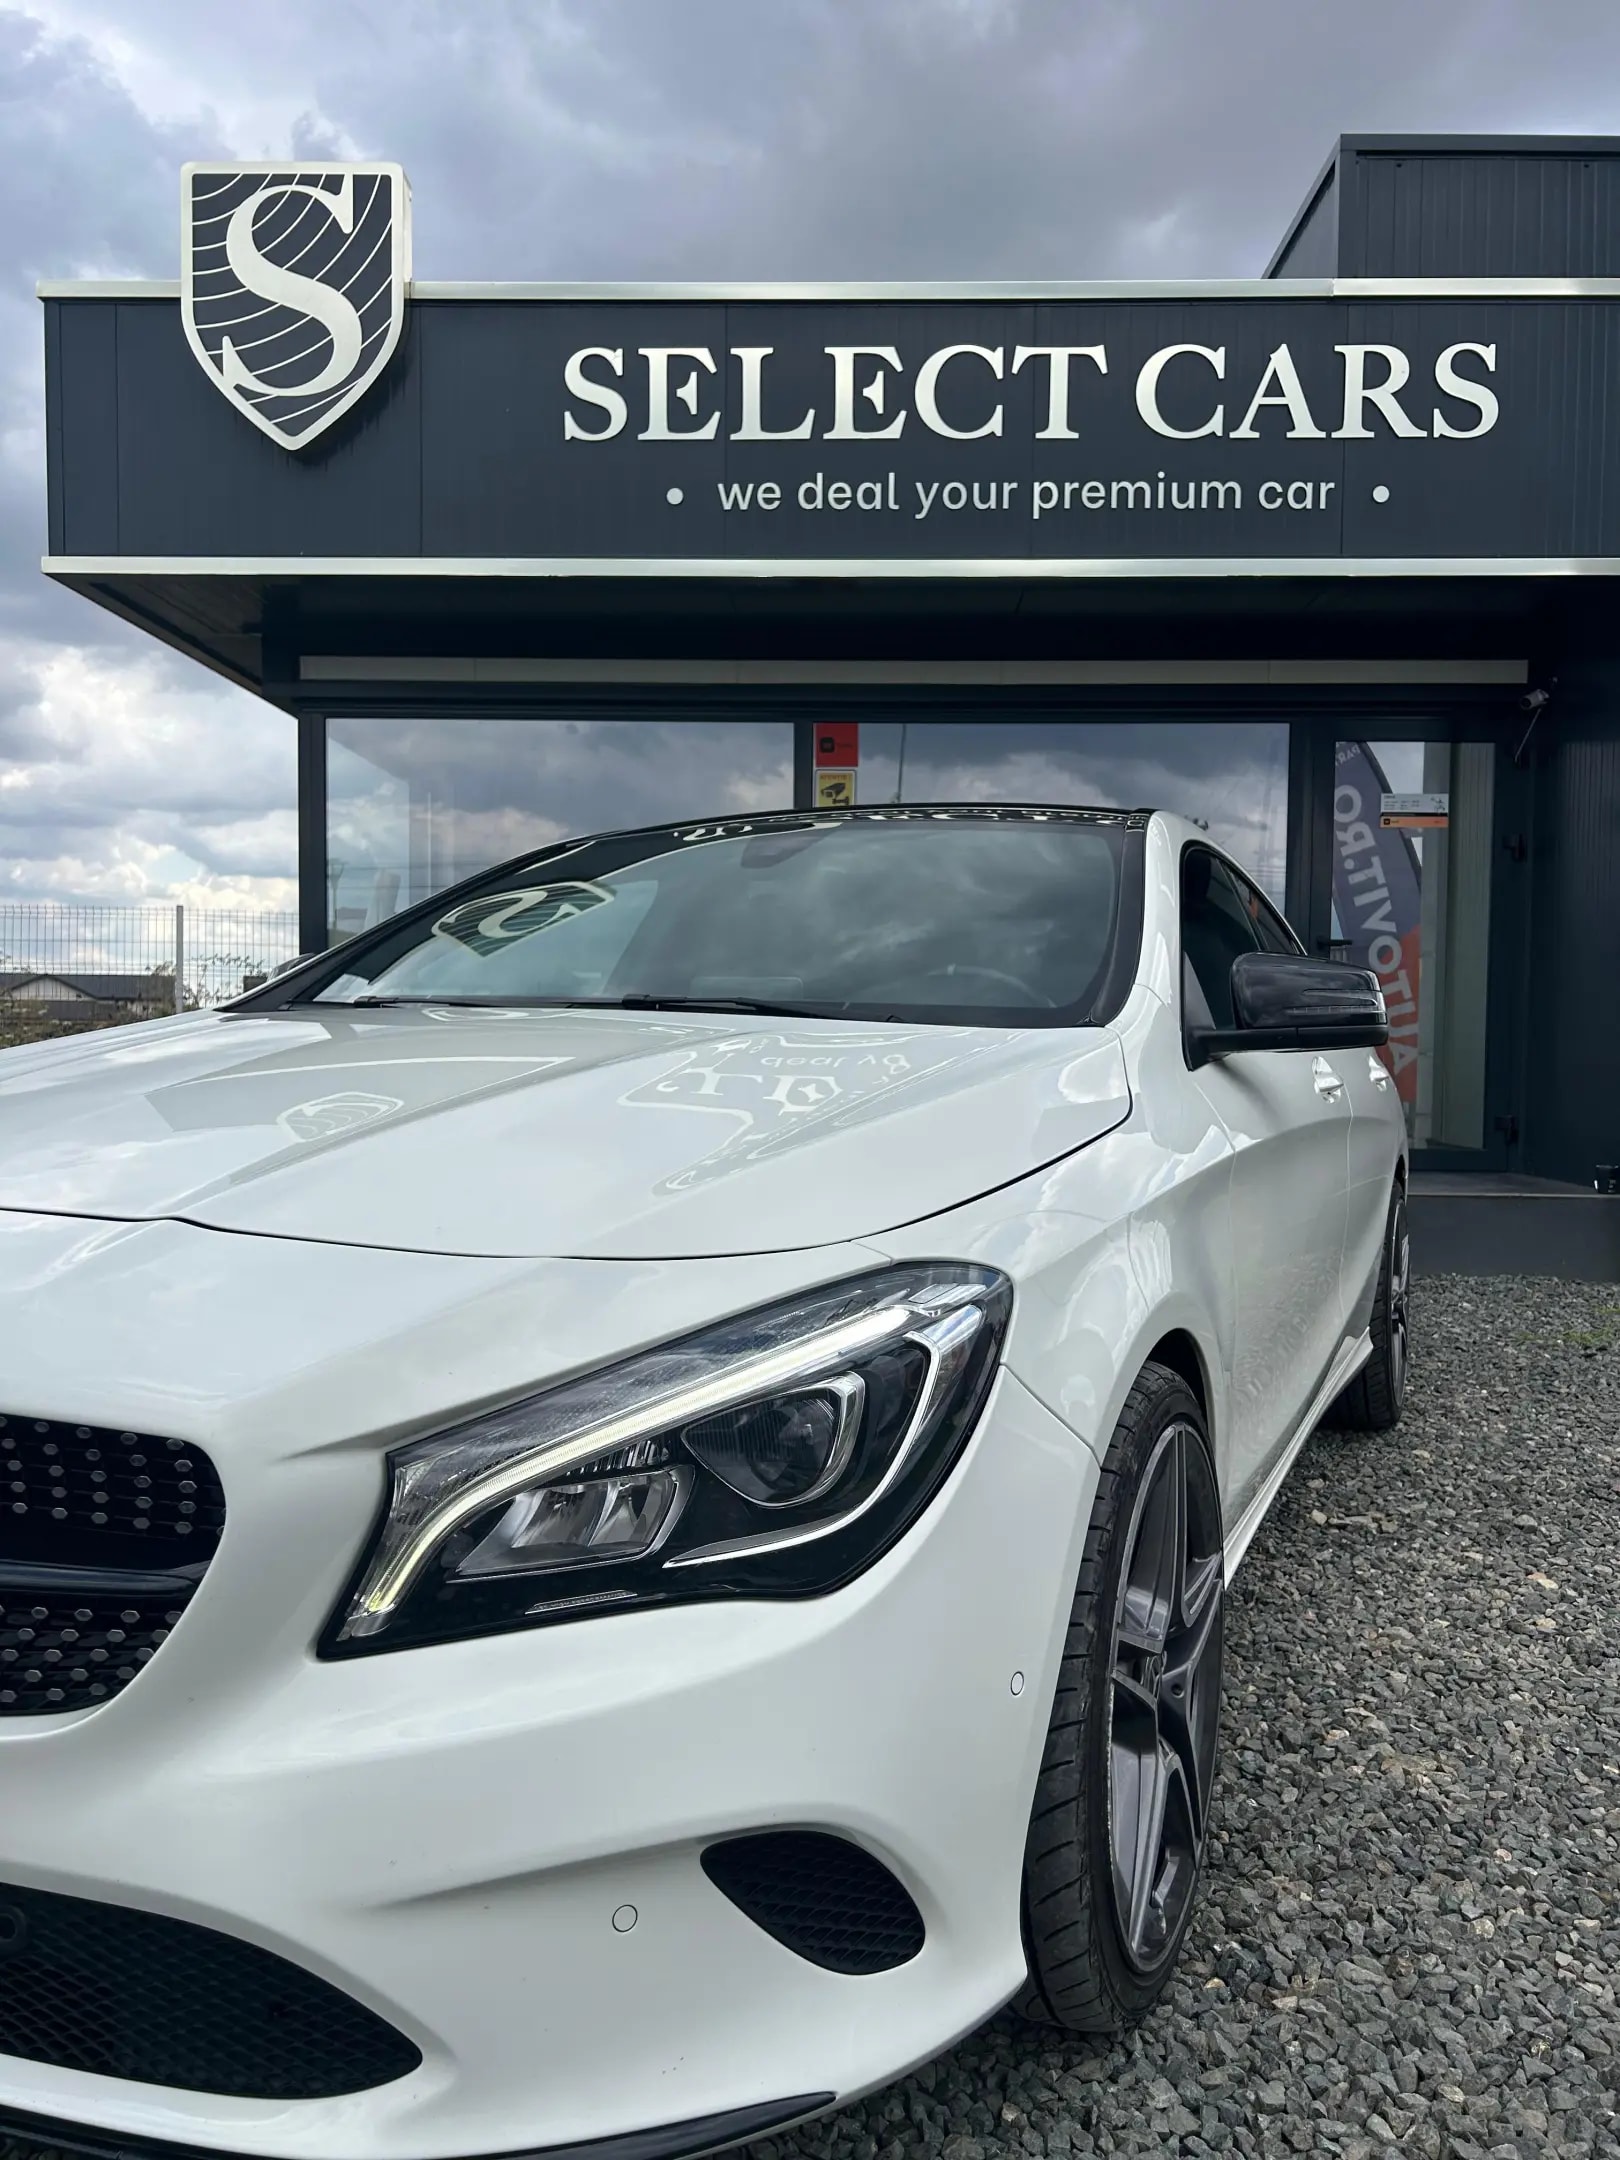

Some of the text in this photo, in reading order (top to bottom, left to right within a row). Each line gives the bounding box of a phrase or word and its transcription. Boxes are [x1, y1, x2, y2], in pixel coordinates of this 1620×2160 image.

[223, 174, 363, 397] S
[563, 342, 1499, 442] SELECT CARS
[717, 471, 1335, 521] we deal your premium car
